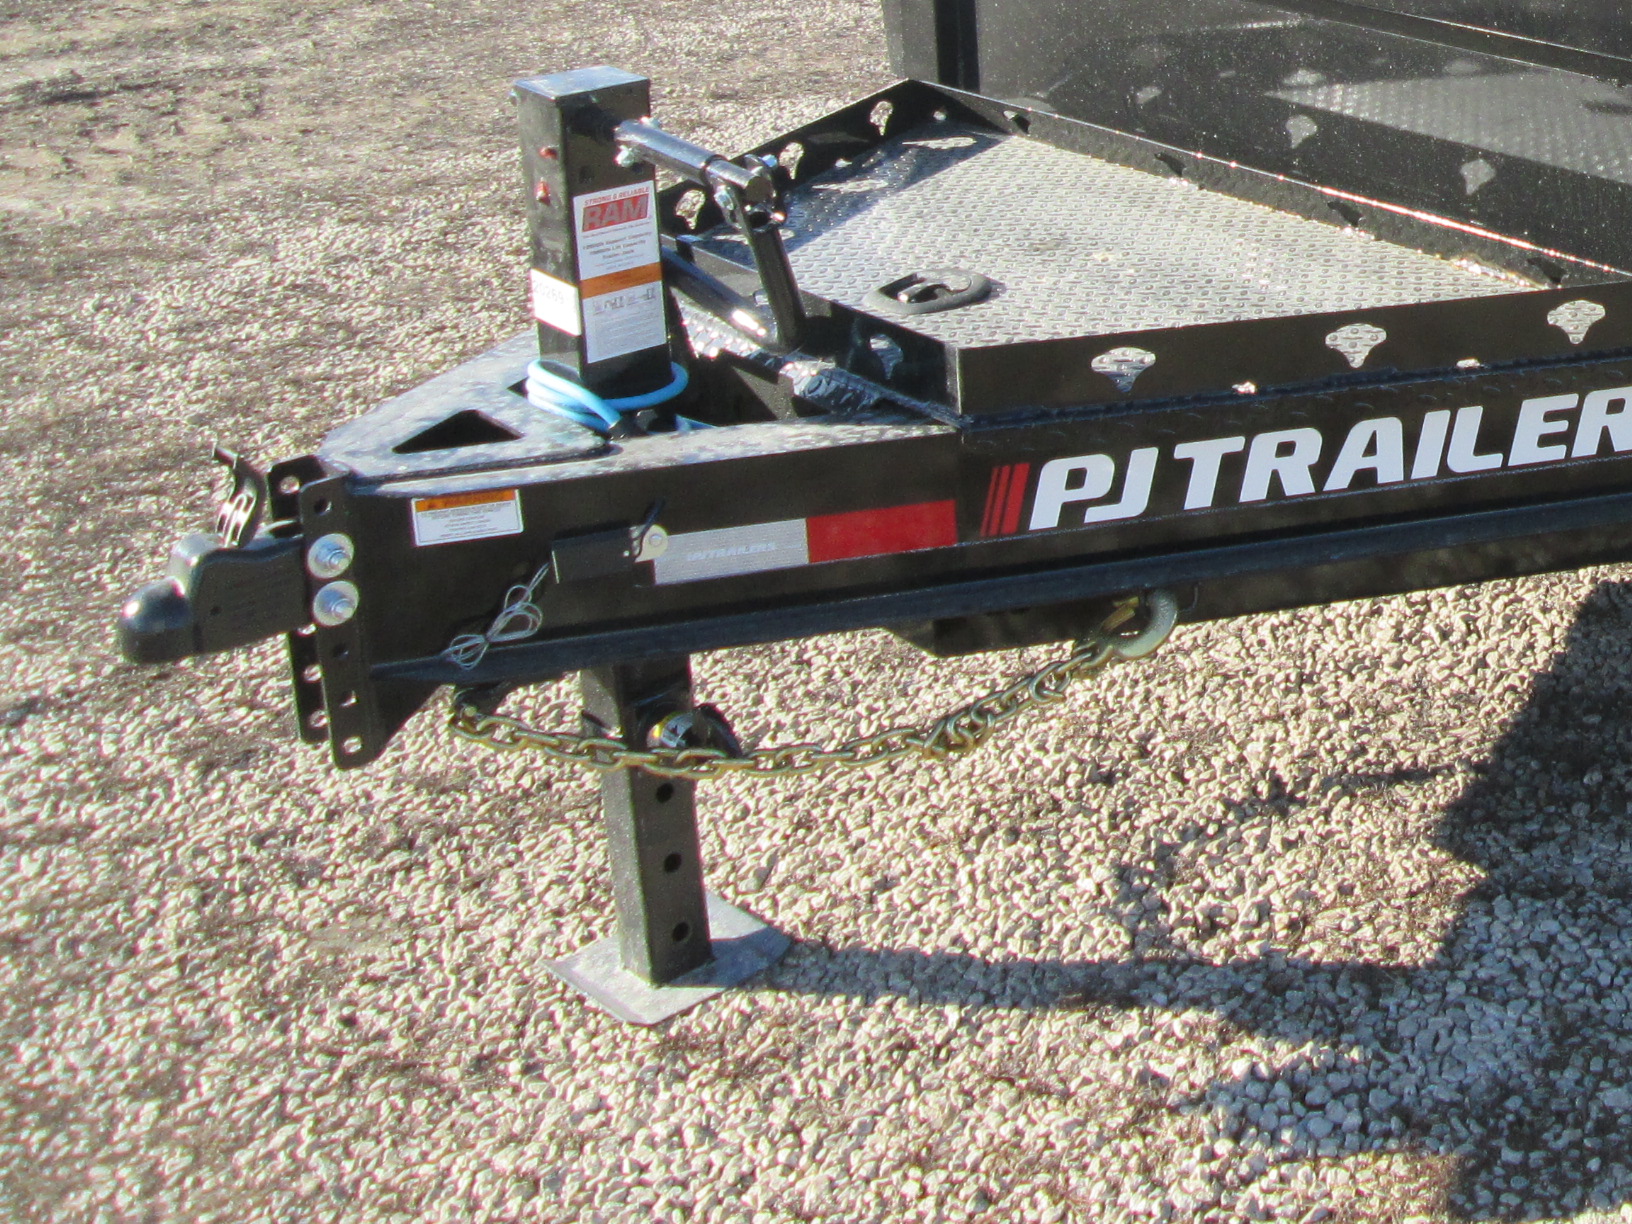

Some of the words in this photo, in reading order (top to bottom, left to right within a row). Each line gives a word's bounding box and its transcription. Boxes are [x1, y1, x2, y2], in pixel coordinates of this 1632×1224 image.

[584, 195, 612, 205] STRONG
[618, 187, 650, 198] RELIABLE
[584, 196, 648, 229] RAM
[1029, 447, 1159, 530] PJ
